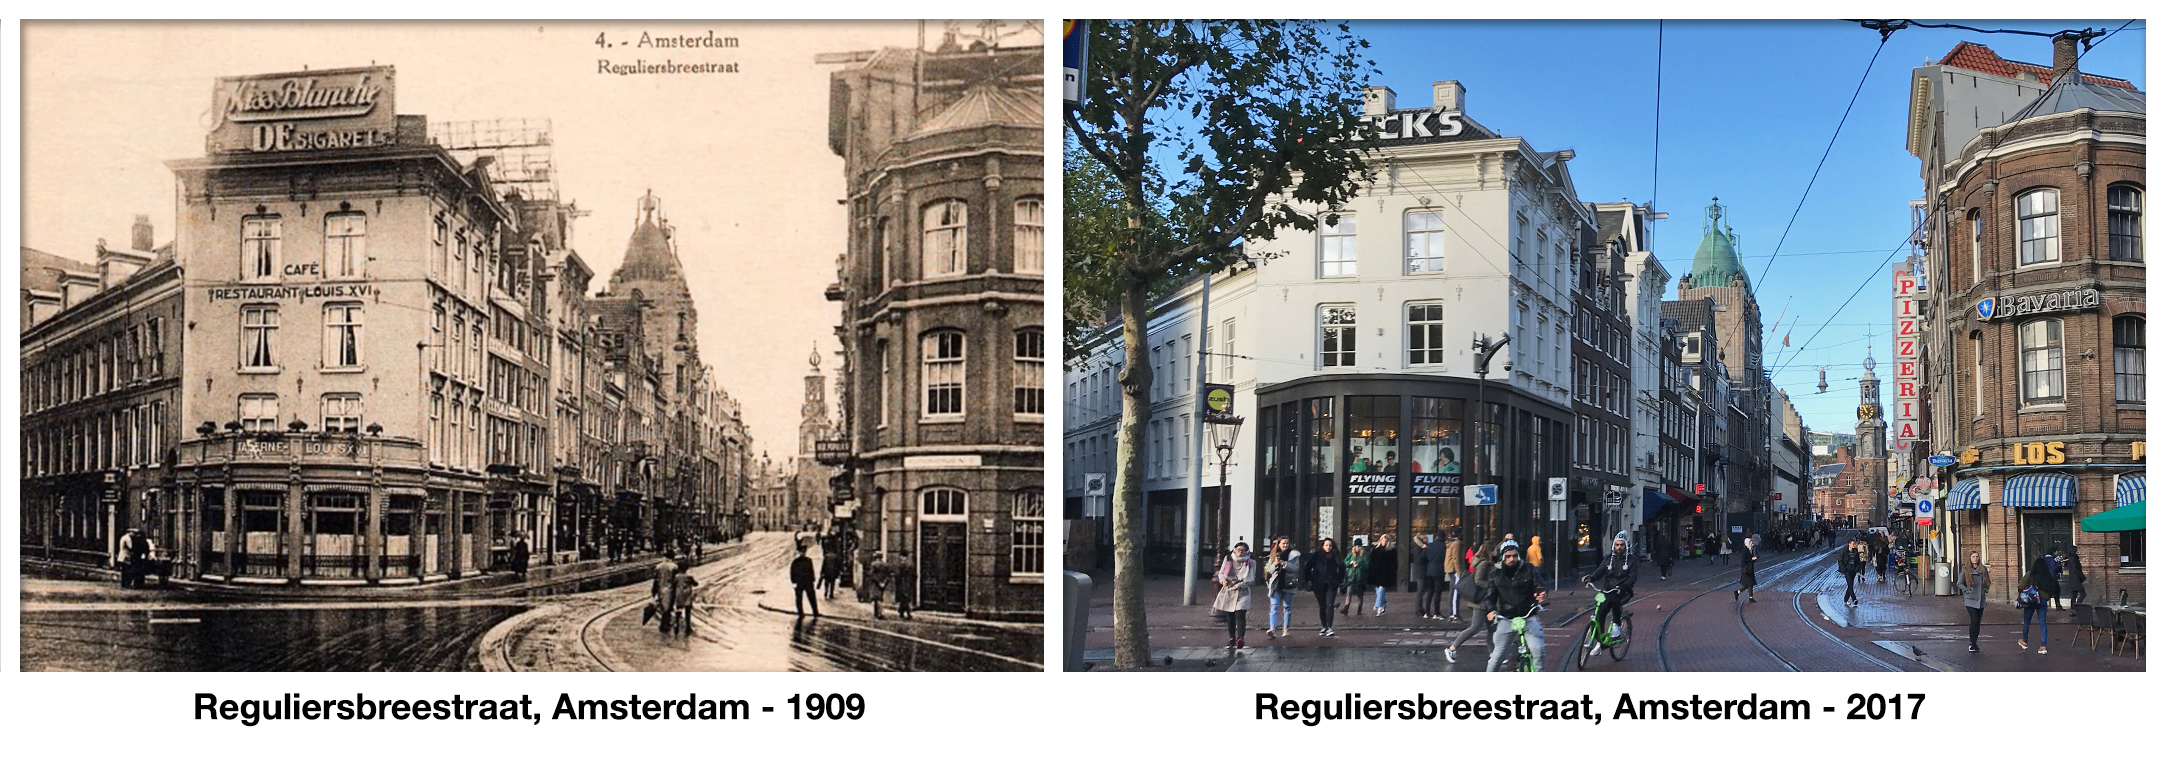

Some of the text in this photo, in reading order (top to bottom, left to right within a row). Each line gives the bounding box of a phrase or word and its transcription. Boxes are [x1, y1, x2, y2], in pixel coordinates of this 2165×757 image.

[275, 74, 382, 111] Blanche
[253, 124, 294, 152] DE
[284, 262, 319, 276] CAFÉ
[215, 285, 373, 300] RESTAURANT LOUIS XVI
[1998, 286, 2099, 317] Bavaria
[1899, 279, 1916, 438] PIZZERIA
[2013, 441, 2065, 465] LOS
[1349, 475, 1397, 483] FLYING
[1414, 475, 1460, 484] FLYING
[1348, 485, 1397, 494] TIGER
[1413, 485, 1460, 494] TIGER
